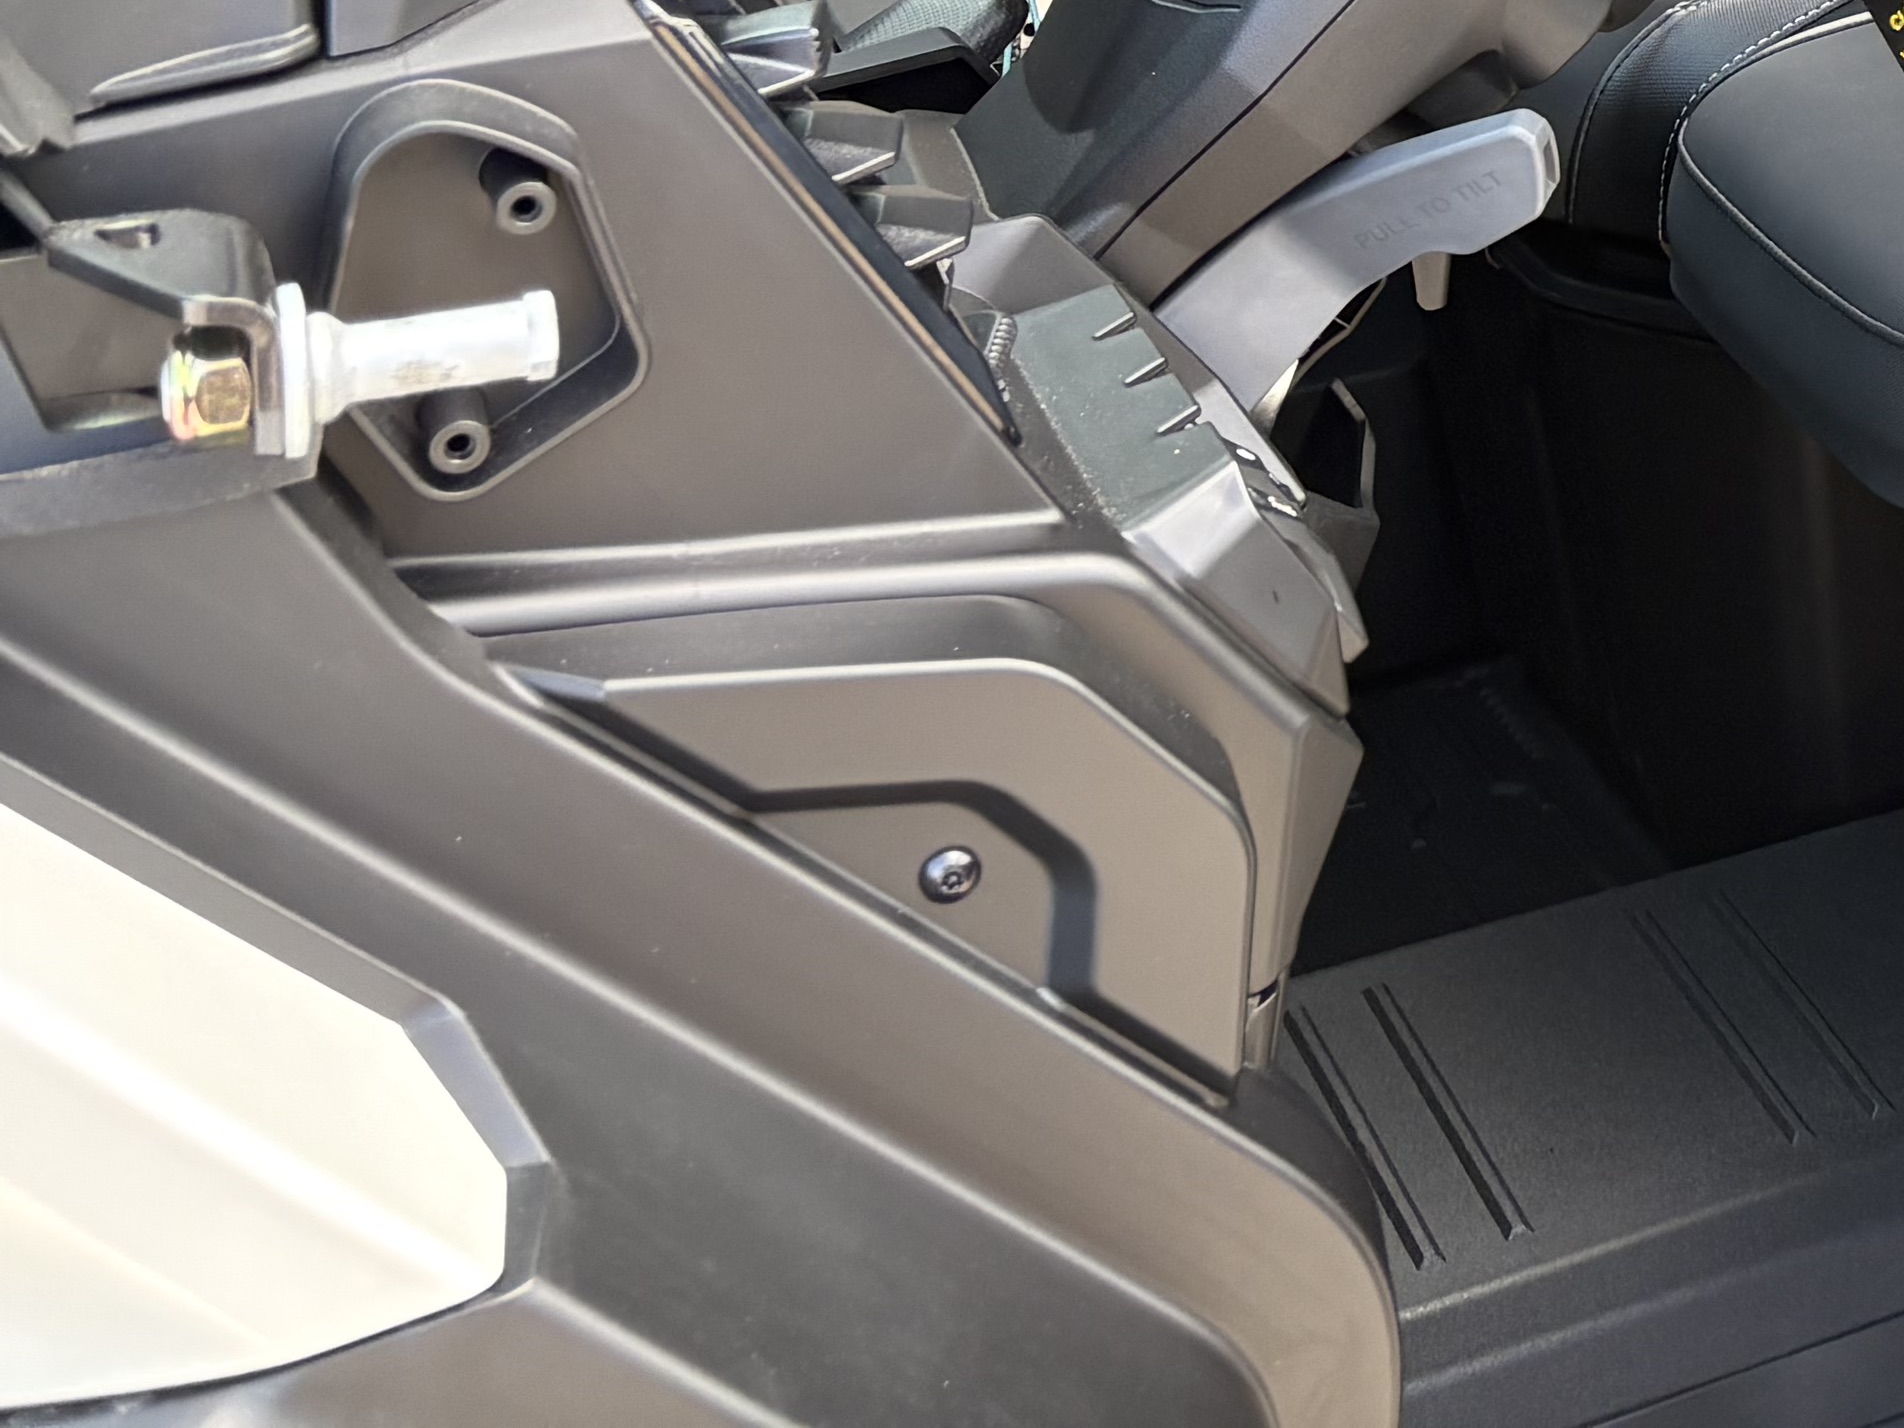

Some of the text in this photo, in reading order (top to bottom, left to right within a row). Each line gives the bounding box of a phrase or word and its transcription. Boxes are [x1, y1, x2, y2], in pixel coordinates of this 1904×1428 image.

[1353, 170, 1502, 249] PULL TO TILT
